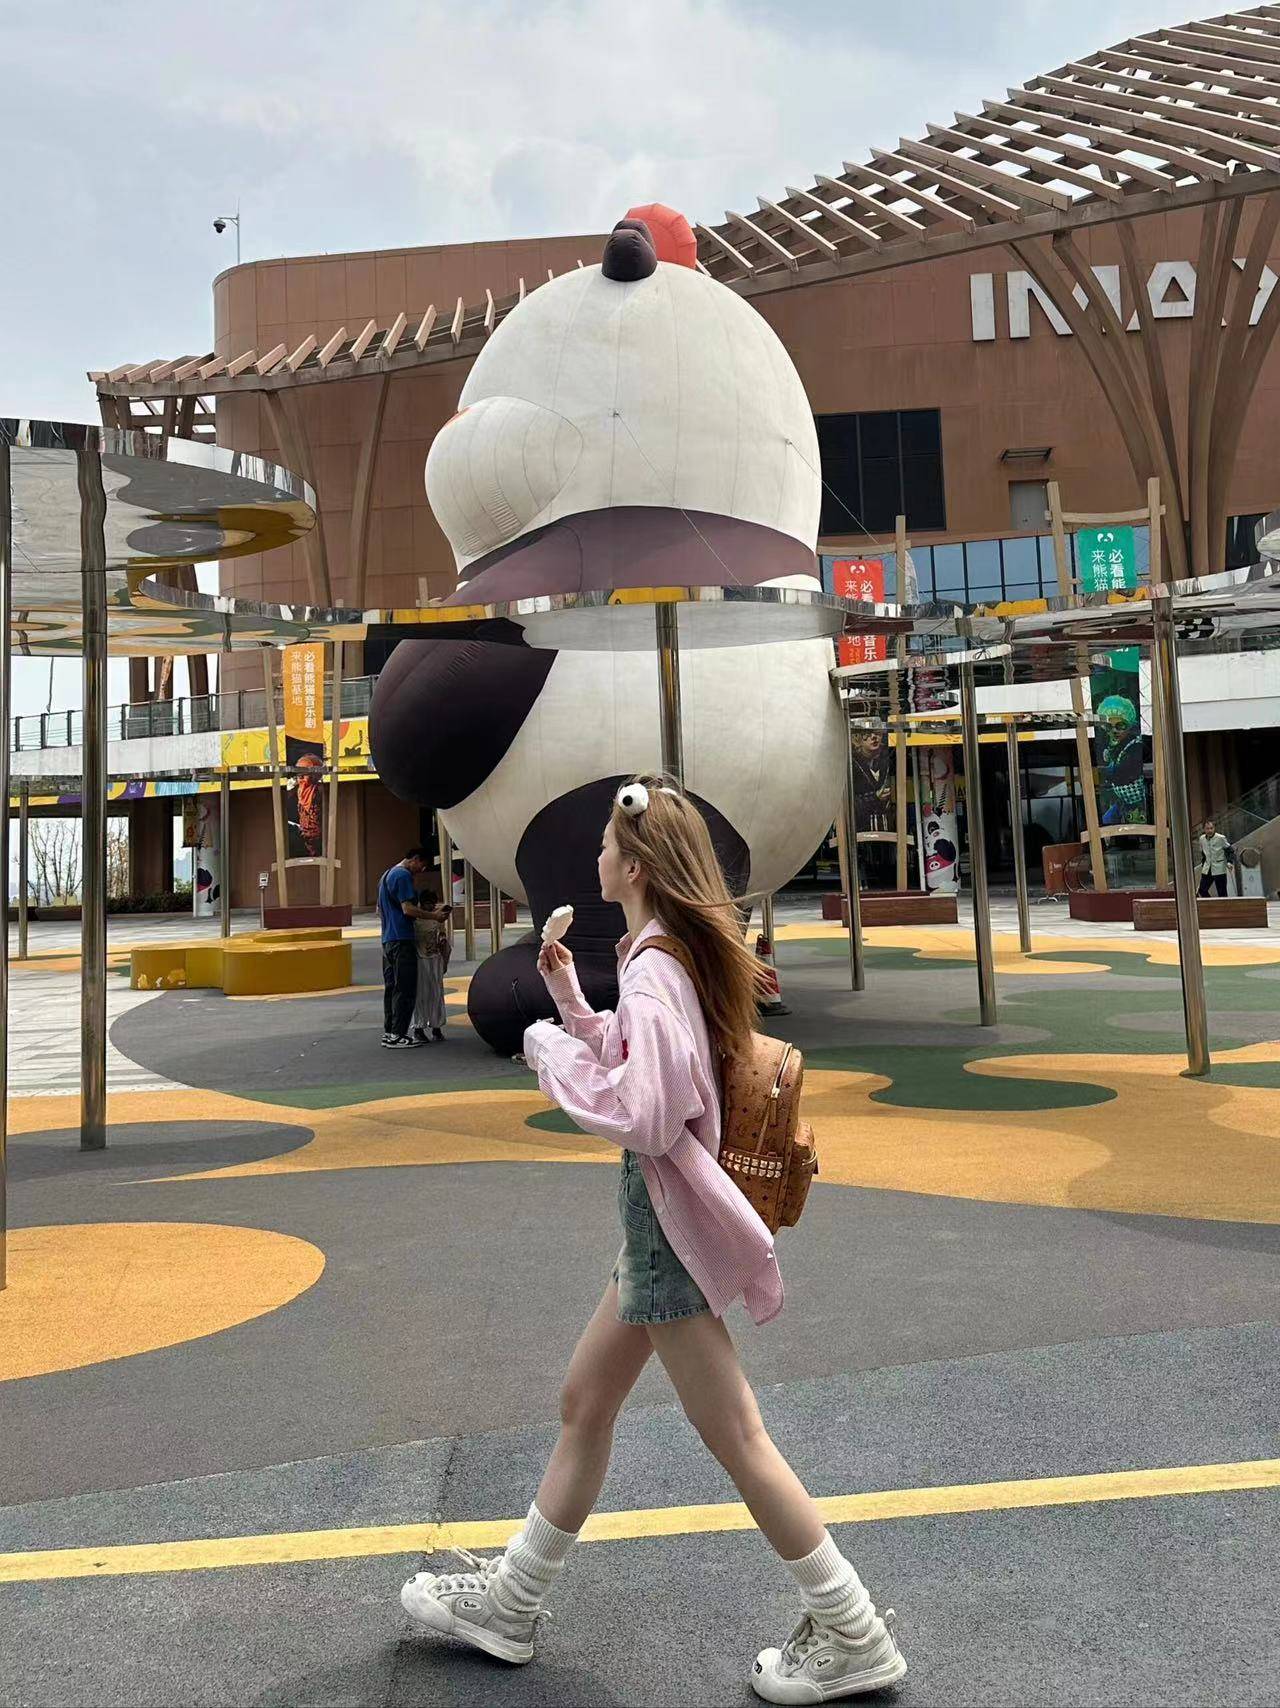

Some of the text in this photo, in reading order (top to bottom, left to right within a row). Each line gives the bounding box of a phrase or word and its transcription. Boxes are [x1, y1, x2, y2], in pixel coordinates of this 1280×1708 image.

[305, 651, 317, 729] 必看熊猫音乐剧
